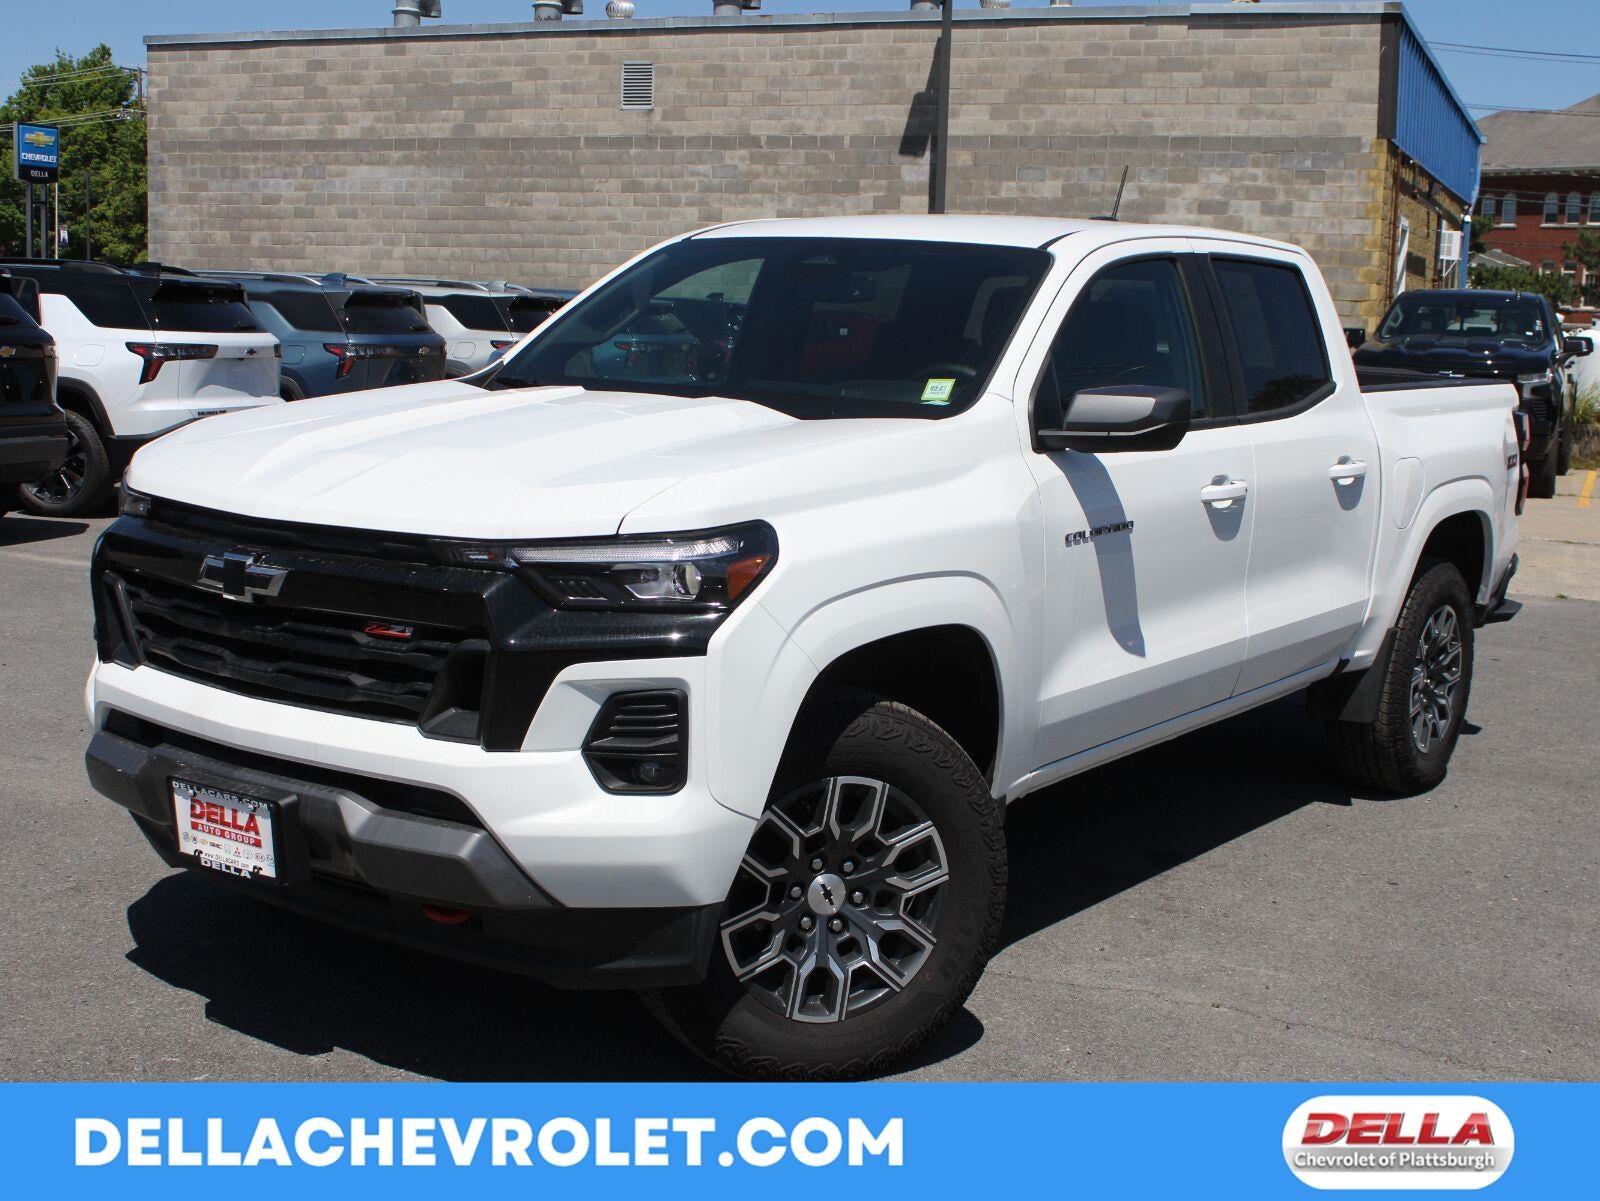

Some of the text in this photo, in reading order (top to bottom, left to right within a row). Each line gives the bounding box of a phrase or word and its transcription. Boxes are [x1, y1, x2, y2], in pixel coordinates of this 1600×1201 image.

[21, 152, 57, 163] CHEVROLET
[30, 169, 49, 178] DELLA
[190, 798, 261, 836] DELLA
[198, 823, 256, 845] AUTO GROUP
[200, 857, 252, 879] DELLA
